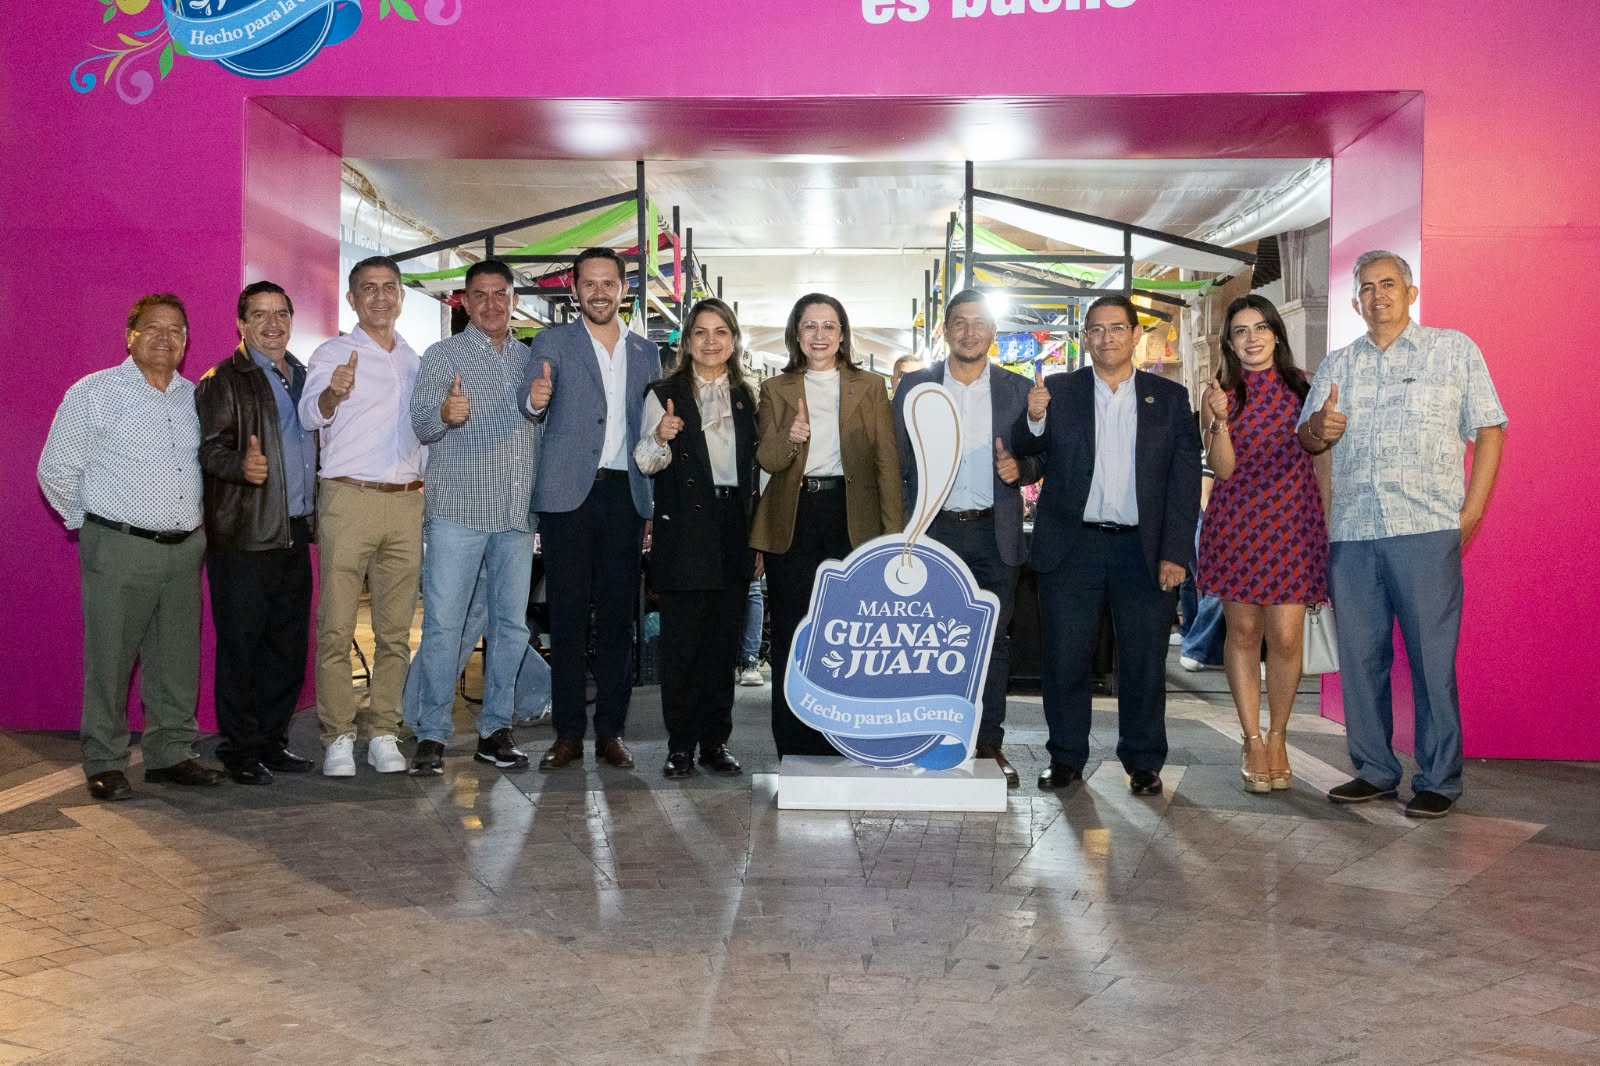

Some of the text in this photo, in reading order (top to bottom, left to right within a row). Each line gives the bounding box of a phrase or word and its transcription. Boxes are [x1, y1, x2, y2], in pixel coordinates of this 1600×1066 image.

[189, 0, 297, 46] Hecho para la
[857, 600, 935, 618] MARCA
[824, 619, 940, 648] GUANA
[845, 650, 966, 679] JUATO
[800, 692, 964, 729] Hecho para la Gente
